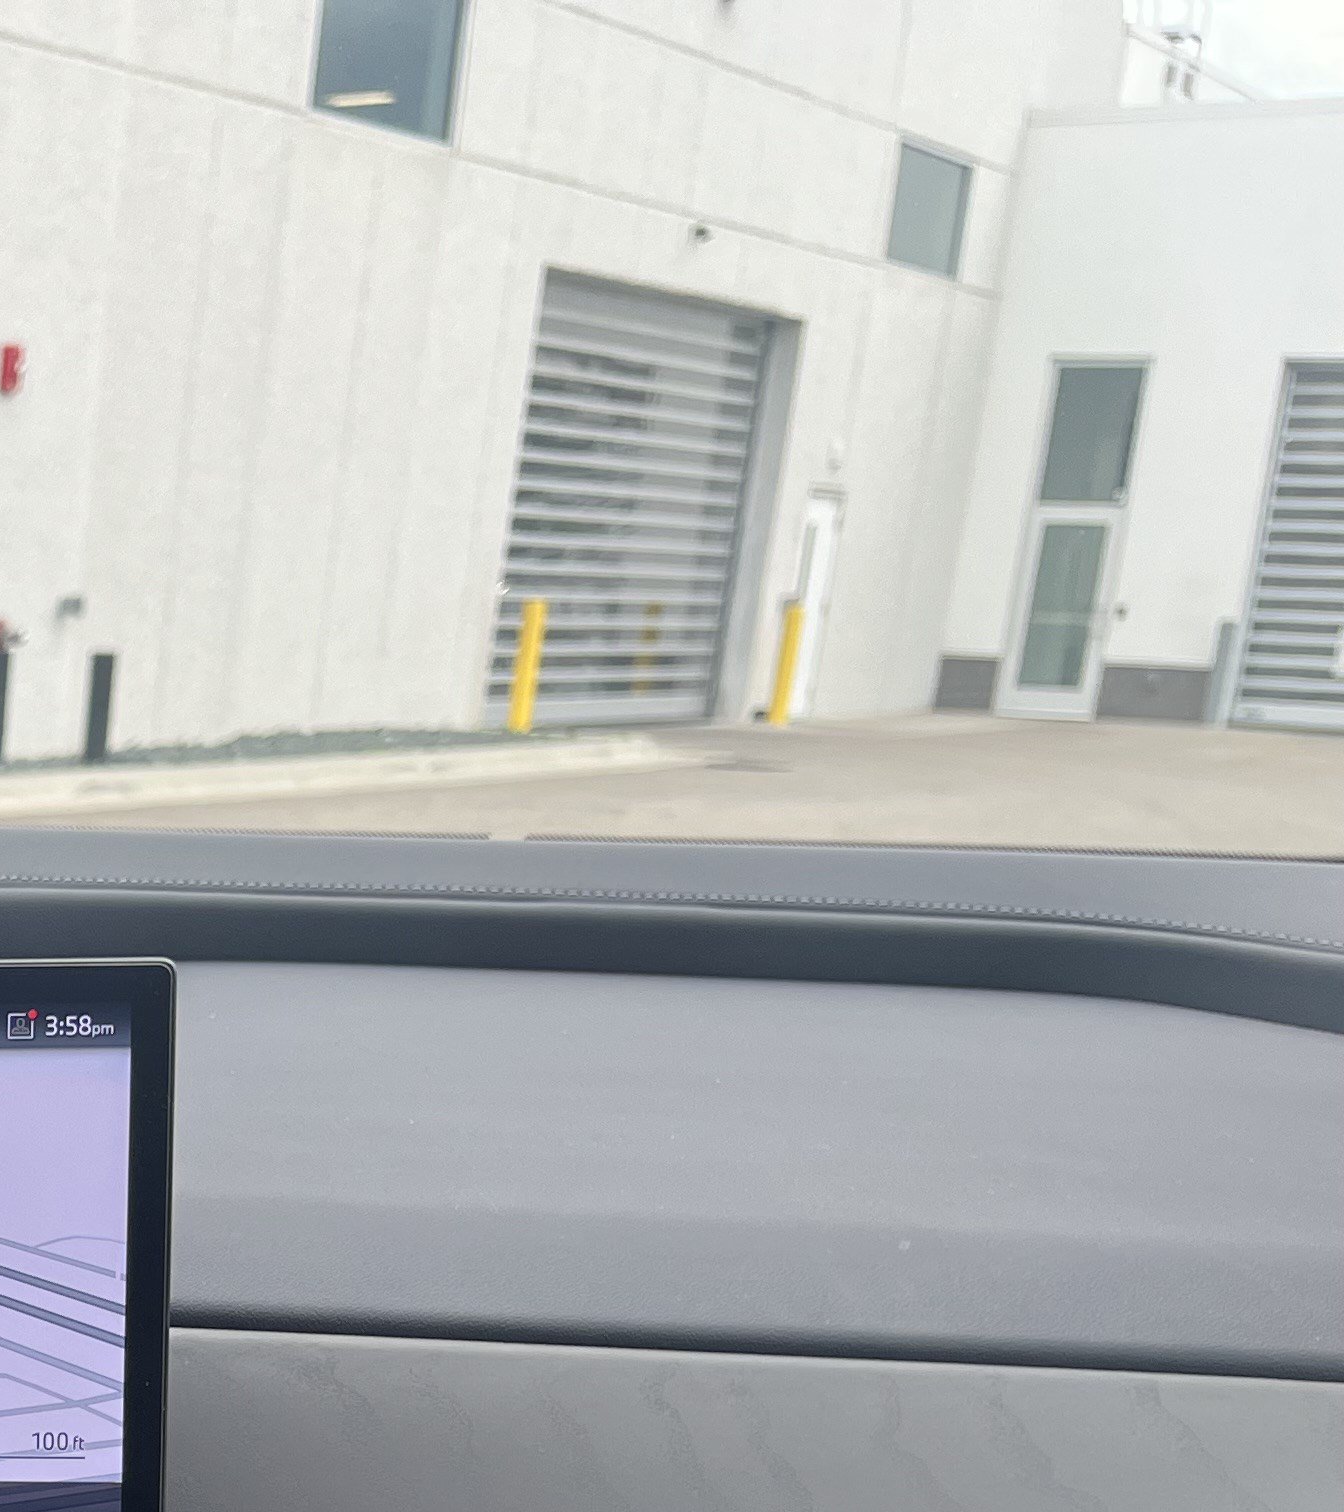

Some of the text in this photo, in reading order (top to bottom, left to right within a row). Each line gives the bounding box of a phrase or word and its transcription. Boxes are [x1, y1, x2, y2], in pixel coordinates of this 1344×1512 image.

[45, 1016, 115, 1038] 3:58pm
[32, 1432, 85, 1451] 100 ft
